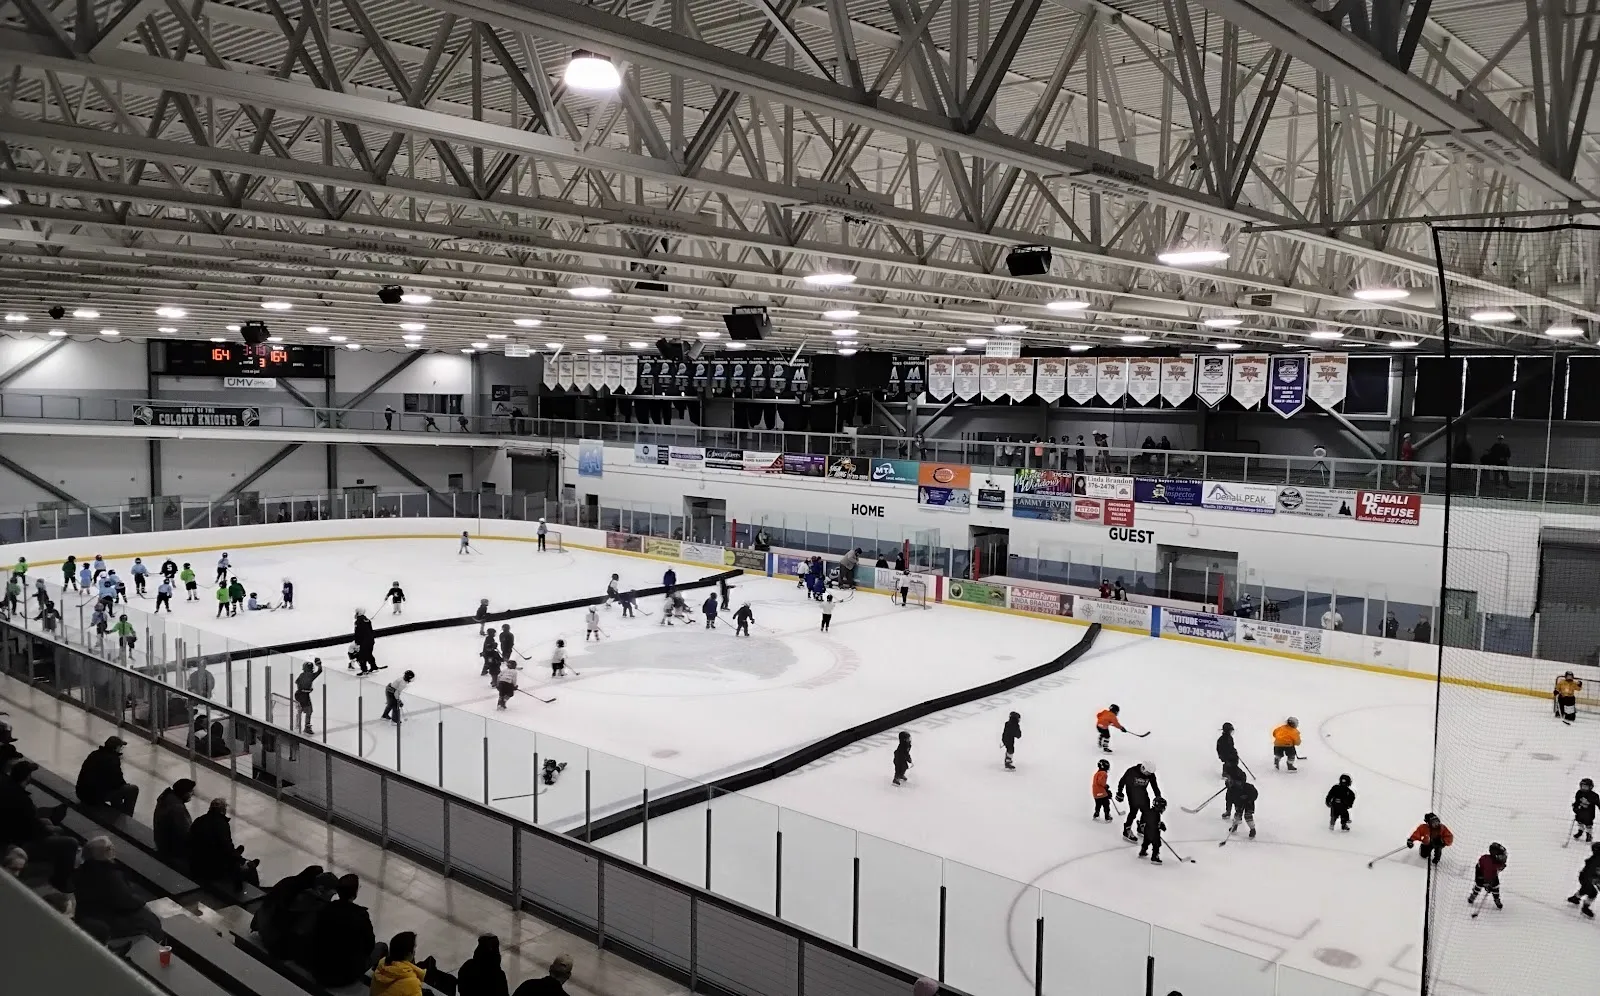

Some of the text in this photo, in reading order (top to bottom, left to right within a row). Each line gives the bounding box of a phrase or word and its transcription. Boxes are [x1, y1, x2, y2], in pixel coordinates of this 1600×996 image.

[212, 349, 230, 361] 164
[270, 351, 287, 363] 164
[259, 358, 266, 368] 3
[159, 413, 237, 426] COLONY KNIGHTS
[875, 466, 896, 475] MTA
[1088, 475, 1133, 485] Linda Brandon
[1014, 497, 1070, 509] TAMMY ERVIN
[1215, 492, 1266, 504] Denali PEAK
[1361, 492, 1409, 505] DENALI
[852, 503, 885, 518] HOME
[1365, 502, 1415, 518] REFUSE
[1109, 527, 1154, 544] GUEST
[1011, 596, 1058, 609] LINDA BRANDON
[1096, 603, 1128, 612] MERIDIAN
[1169, 614, 1198, 625] ALTITUDE
[1178, 625, 1224, 639] 907-745-5444
